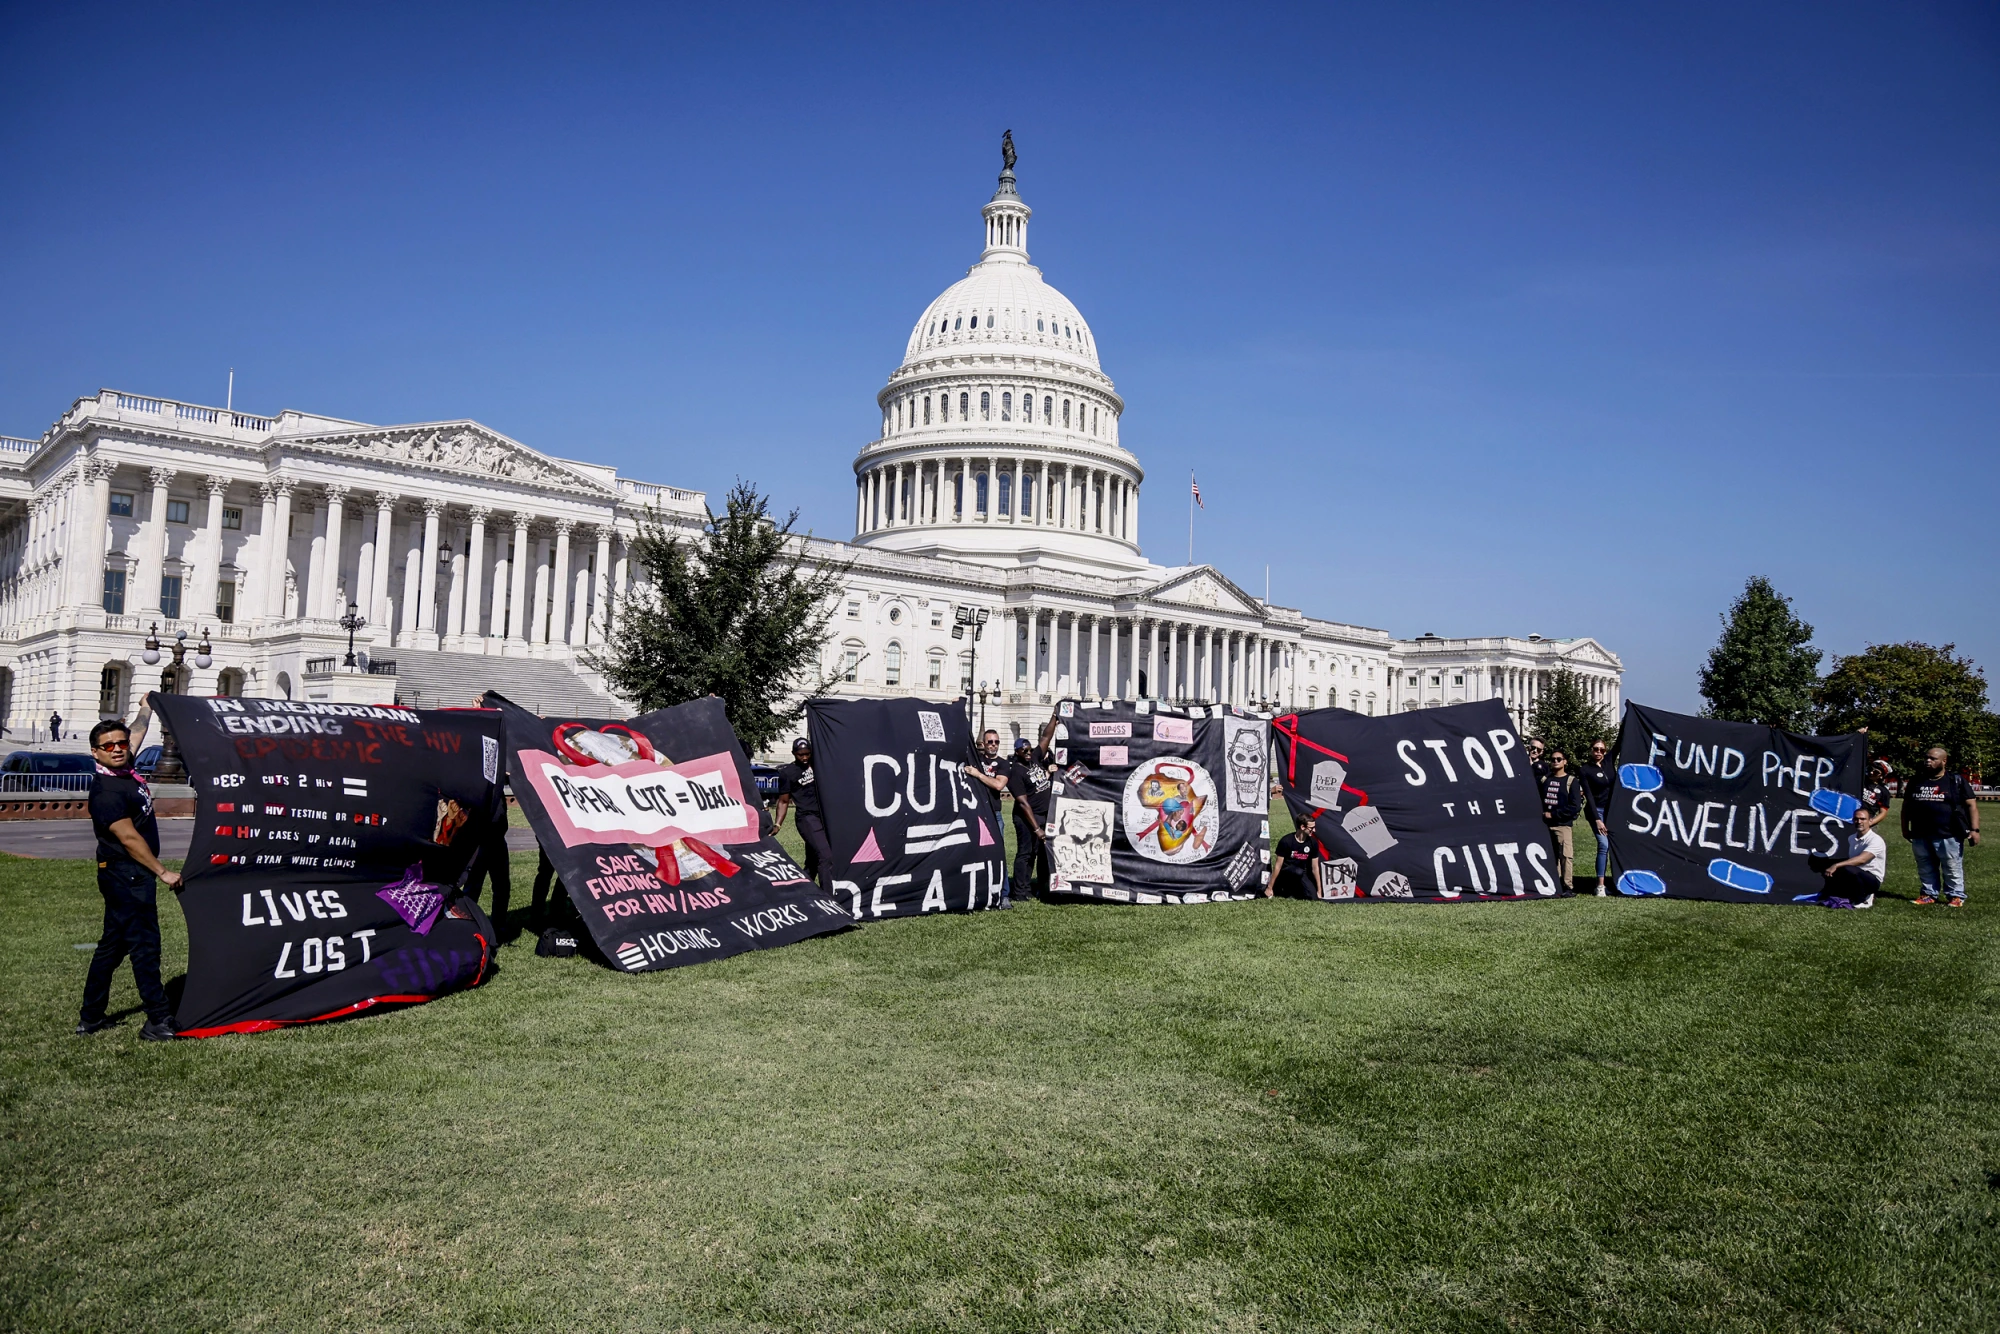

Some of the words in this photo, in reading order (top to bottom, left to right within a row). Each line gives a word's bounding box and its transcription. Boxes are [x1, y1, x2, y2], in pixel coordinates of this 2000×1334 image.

[207, 699, 245, 712] IN
[257, 701, 420, 723] MEMORIAM:
[223, 715, 343, 735] ENDING
[354, 720, 414, 747] THE
[422, 730, 462, 754] HIV
[235, 737, 382, 764] EPIDEMIC
[1396, 729, 1516, 787] STOP
[1648, 732, 1745, 780] FUND
[213, 774, 246, 788] DEEP
[262, 774, 290, 786] CUTS
[298, 774, 308, 788] 2
[863, 752, 978, 818] CUTS
[242, 804, 255, 814] NO
[265, 805, 285, 816] HIV
[291, 808, 328, 820] TESTING
[335, 812, 347, 821] OR
[625, 783, 677, 817] CUTS
[1443, 799, 1506, 818] THE
[236, 825, 261, 839] HIV
[268, 831, 300, 842] CASES
[308, 834, 321, 844] UP
[1349, 816, 1380, 833] MEDICAID
[256, 855, 282, 865] RYAN
[291, 855, 319, 866] WHITE
[595, 854, 645, 875] SAVE
[754, 863, 806, 880] LIVES
[1433, 842, 1557, 898] CUTS
[586, 872, 662, 900] FUNDING
[1377, 874, 1401, 897] HIV
[242, 889, 348, 927] LIVES
[602, 898, 646, 922] FOR
[640, 928, 721, 961] HOUSING
[731, 903, 808, 938] WORKS
[274, 929, 376, 979] LOST
